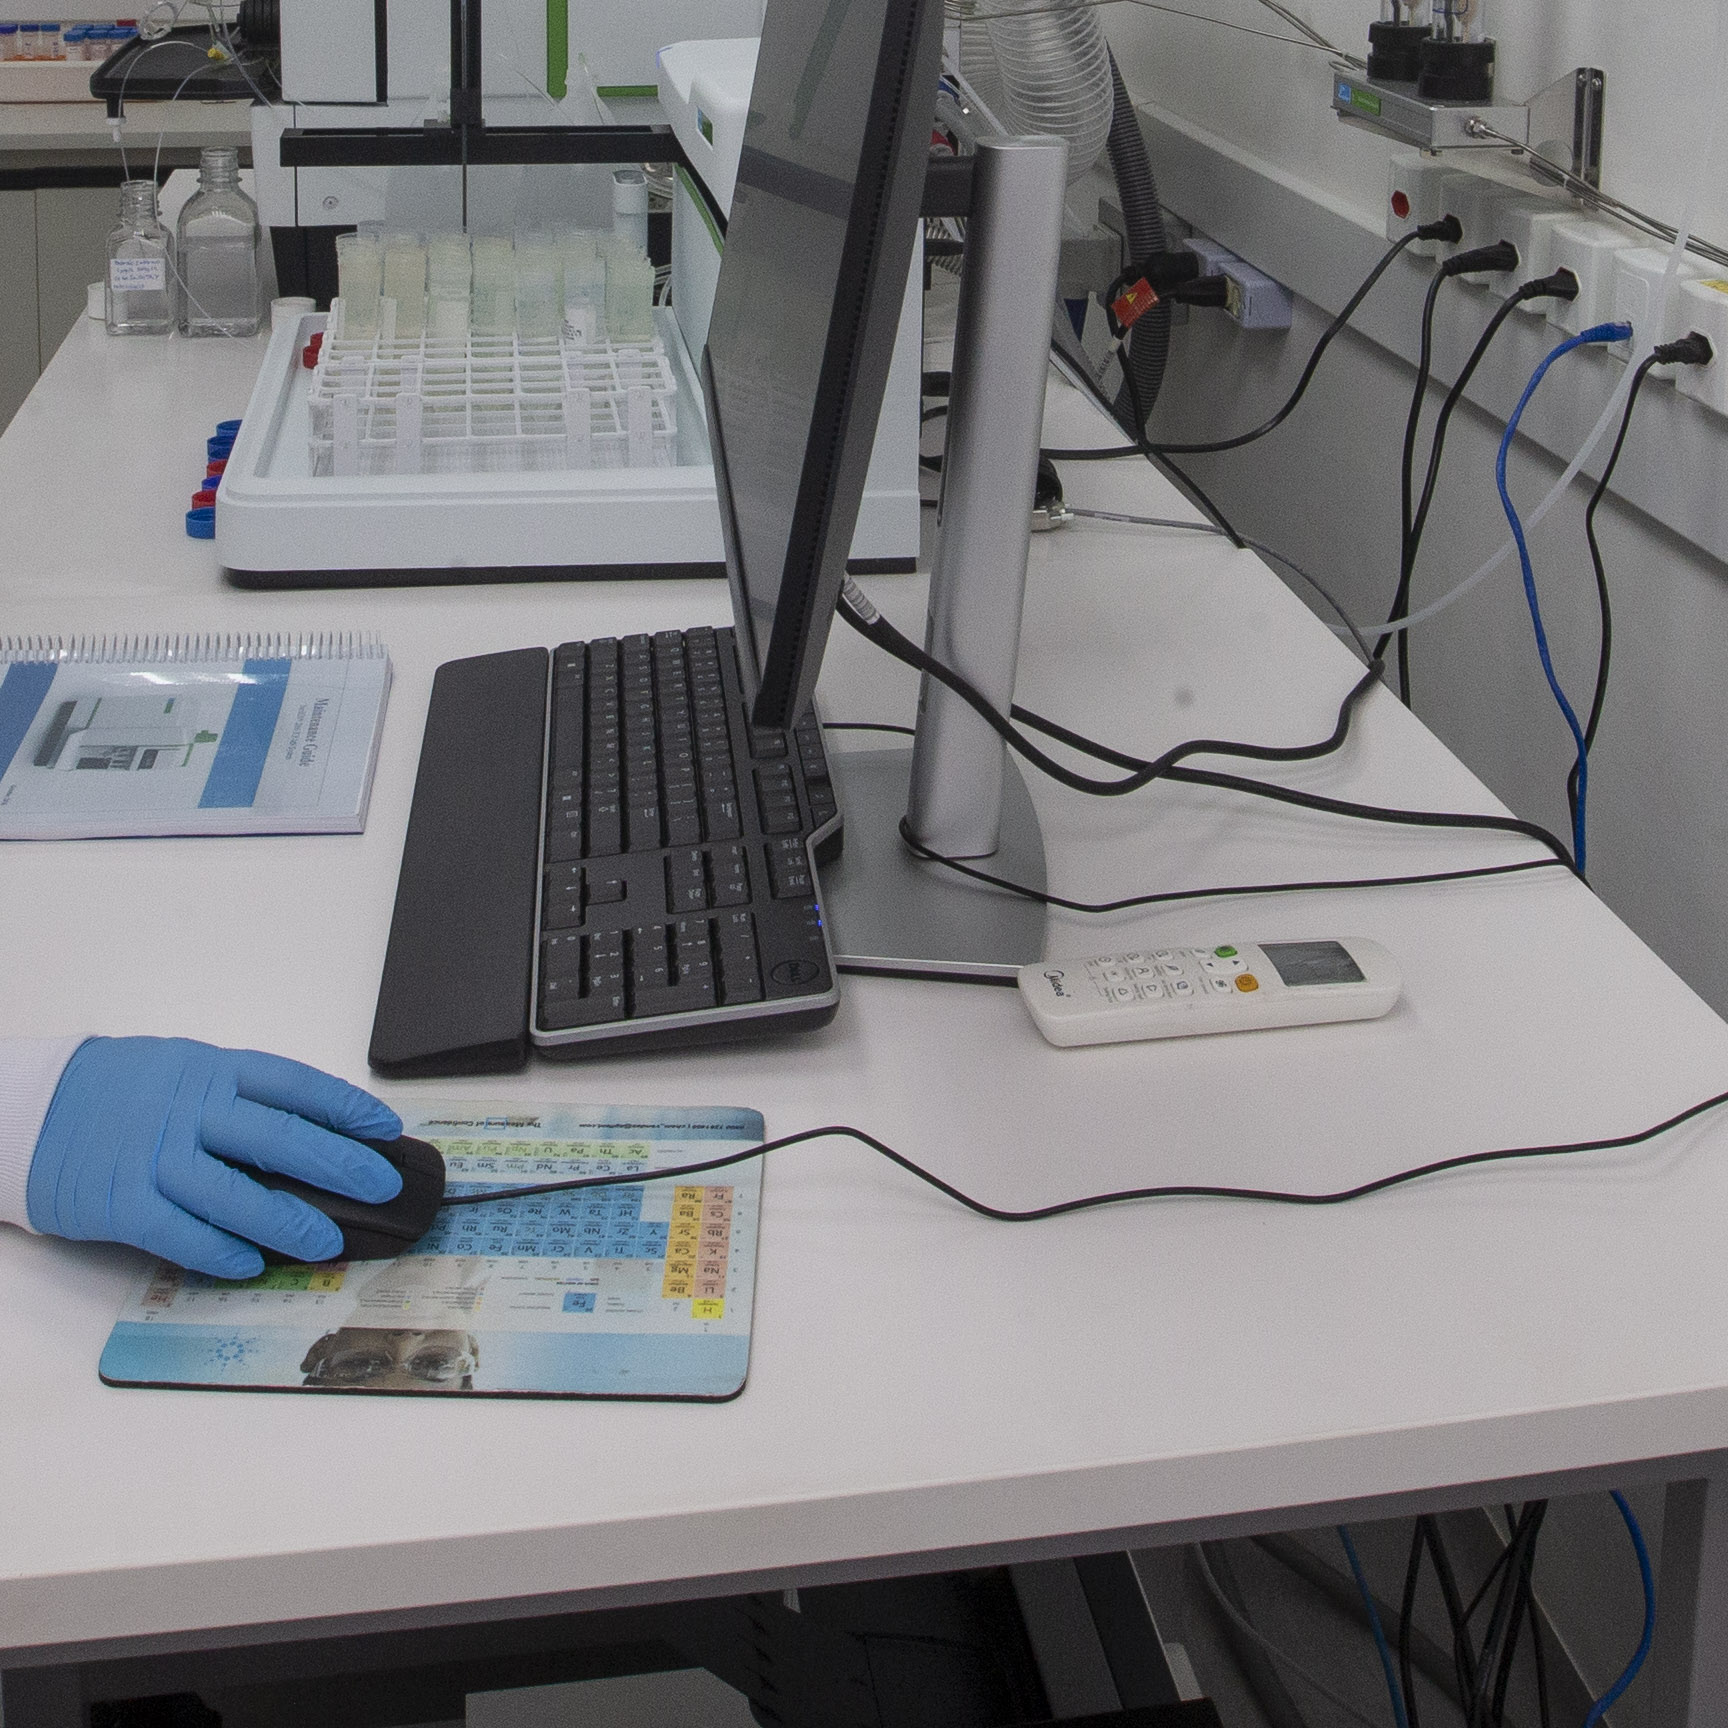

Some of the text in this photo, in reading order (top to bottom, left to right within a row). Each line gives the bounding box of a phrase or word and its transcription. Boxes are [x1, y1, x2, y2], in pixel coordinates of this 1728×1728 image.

[305, 698, 329, 742] Maintenance
[299, 744, 318, 767] Guide
[1043, 970, 1065, 997] Midea
